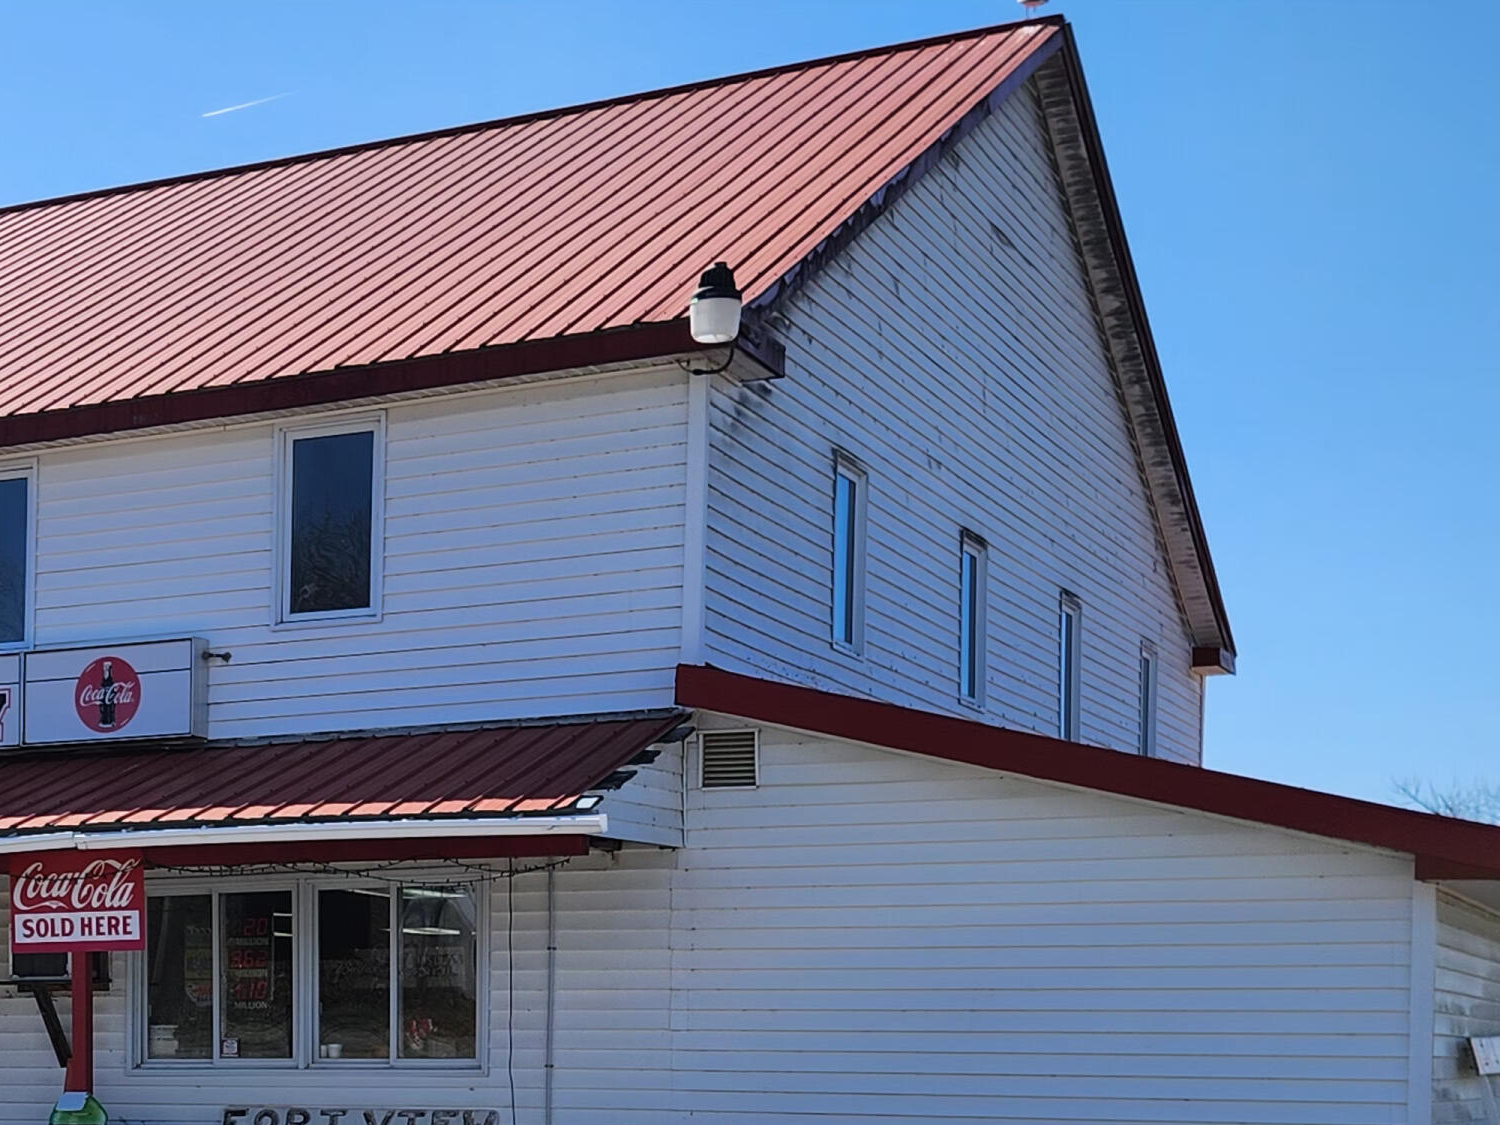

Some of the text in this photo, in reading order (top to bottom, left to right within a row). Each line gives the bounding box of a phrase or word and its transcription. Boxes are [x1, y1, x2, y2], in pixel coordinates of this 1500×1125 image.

[78, 681, 136, 707] Coca-Cola
[13, 859, 140, 911] Coca-Cola
[21, 915, 133, 939] SOLD HERE
